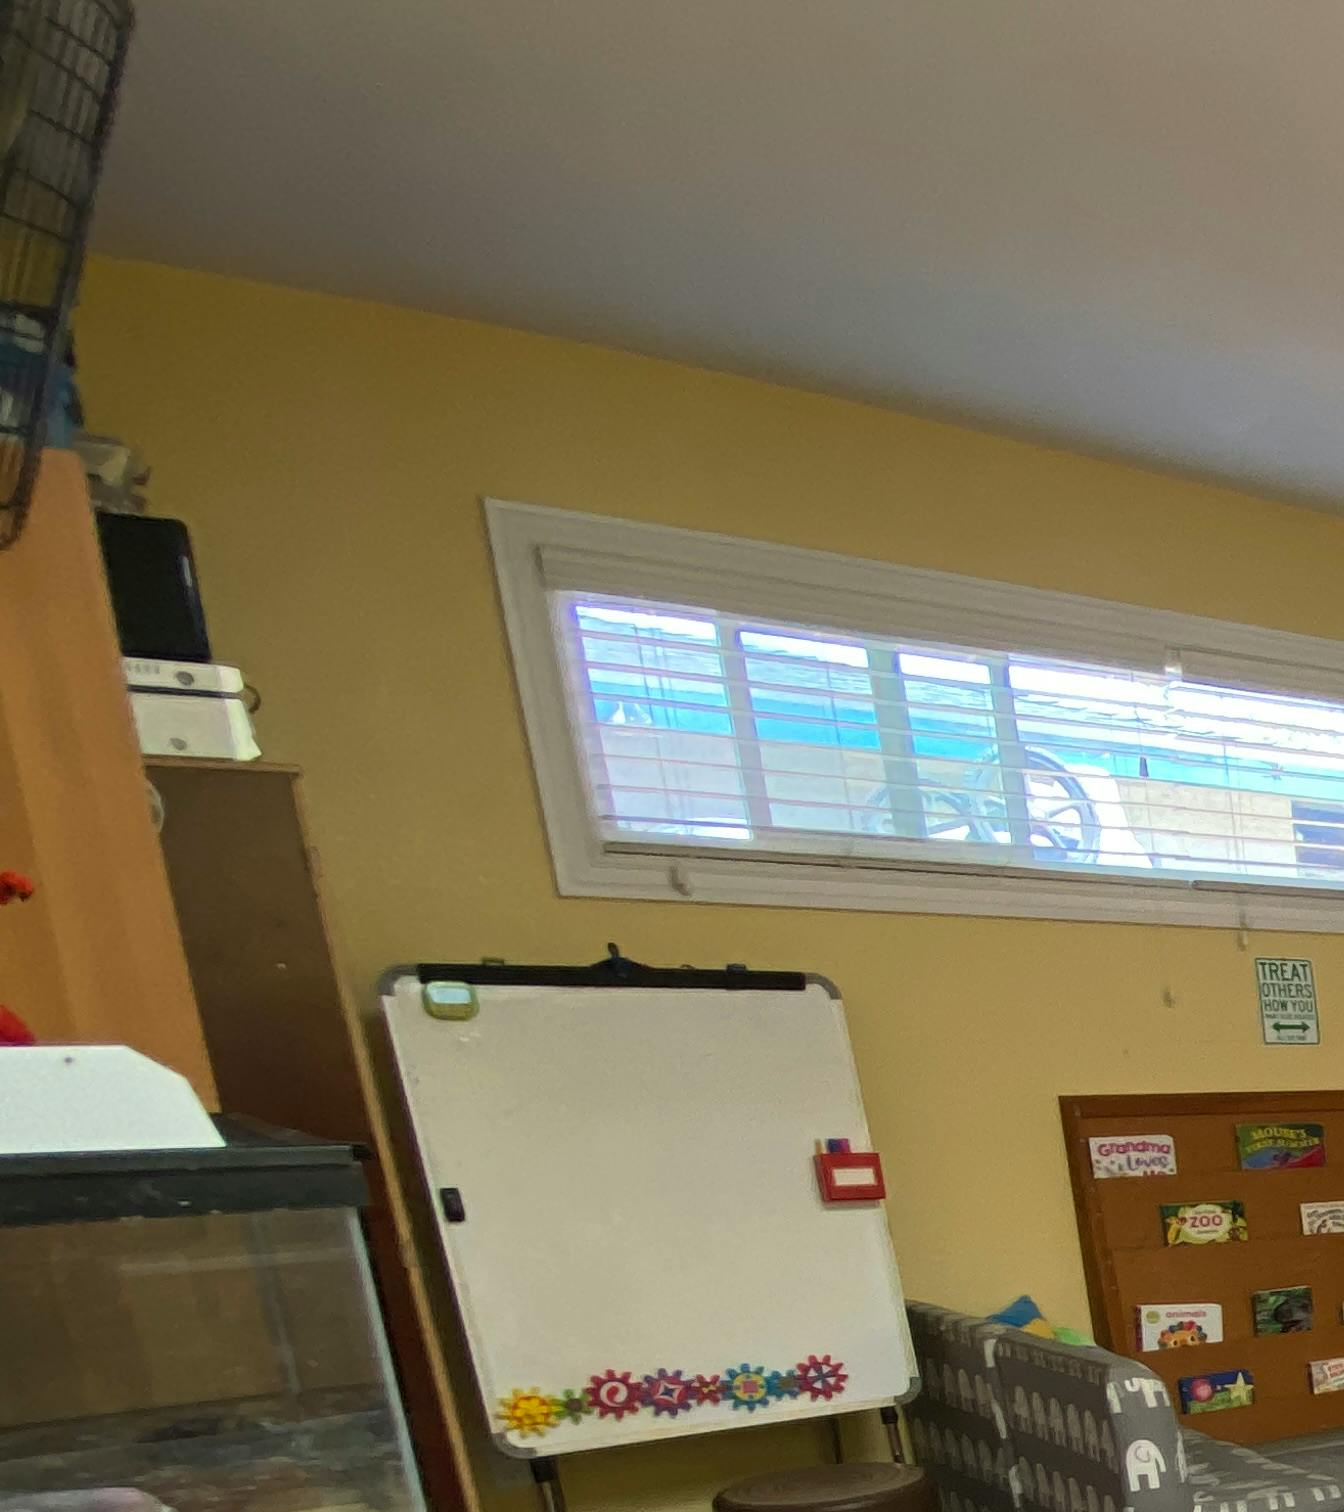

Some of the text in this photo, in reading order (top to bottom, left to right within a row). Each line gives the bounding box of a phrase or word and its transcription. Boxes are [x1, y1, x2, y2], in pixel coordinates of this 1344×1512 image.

[1259, 962, 1308, 982] TREAT
[1262, 982, 1313, 998] OTHERS
[1264, 999, 1313, 1013] HOW YOU
[1098, 1141, 1171, 1157] Grandma
[1166, 1309, 1206, 1319] animals
